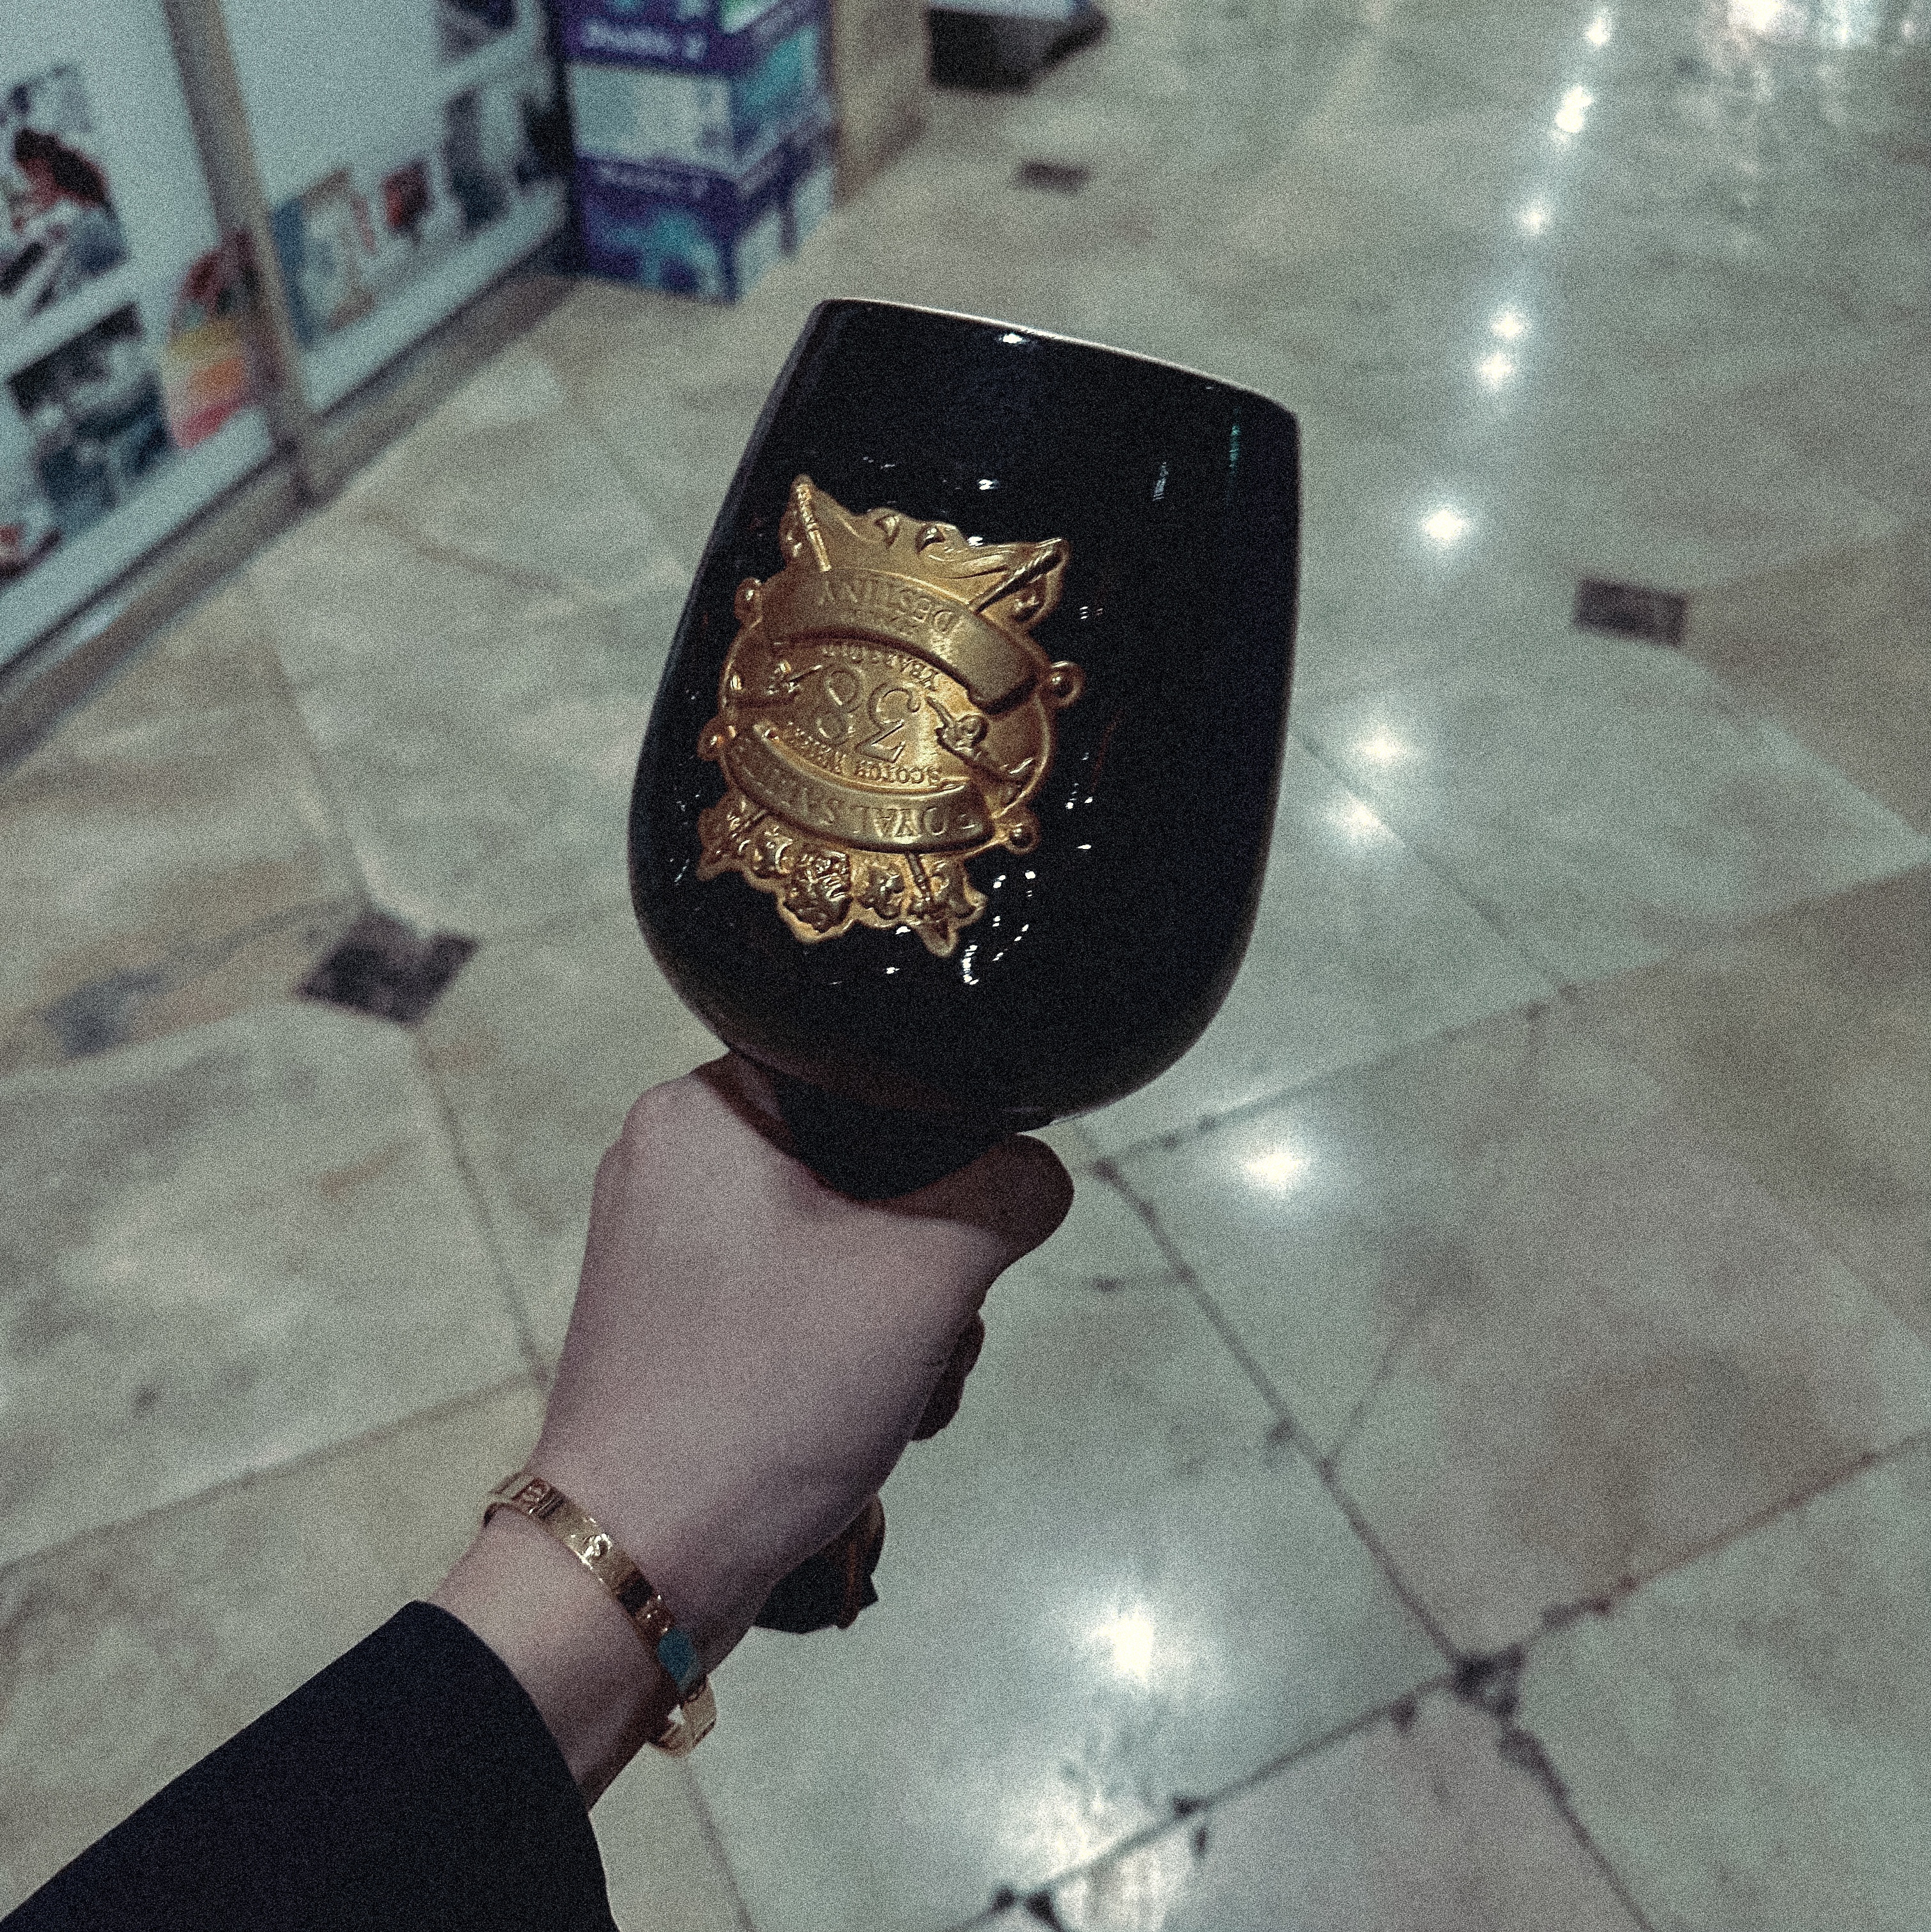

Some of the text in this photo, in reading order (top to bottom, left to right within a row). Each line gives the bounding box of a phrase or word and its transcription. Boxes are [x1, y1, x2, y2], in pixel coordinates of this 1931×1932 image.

[816, 576, 960, 632] DESTINY
[816, 663, 921, 763] 38
[855, 760, 941, 785] SCOTCH
